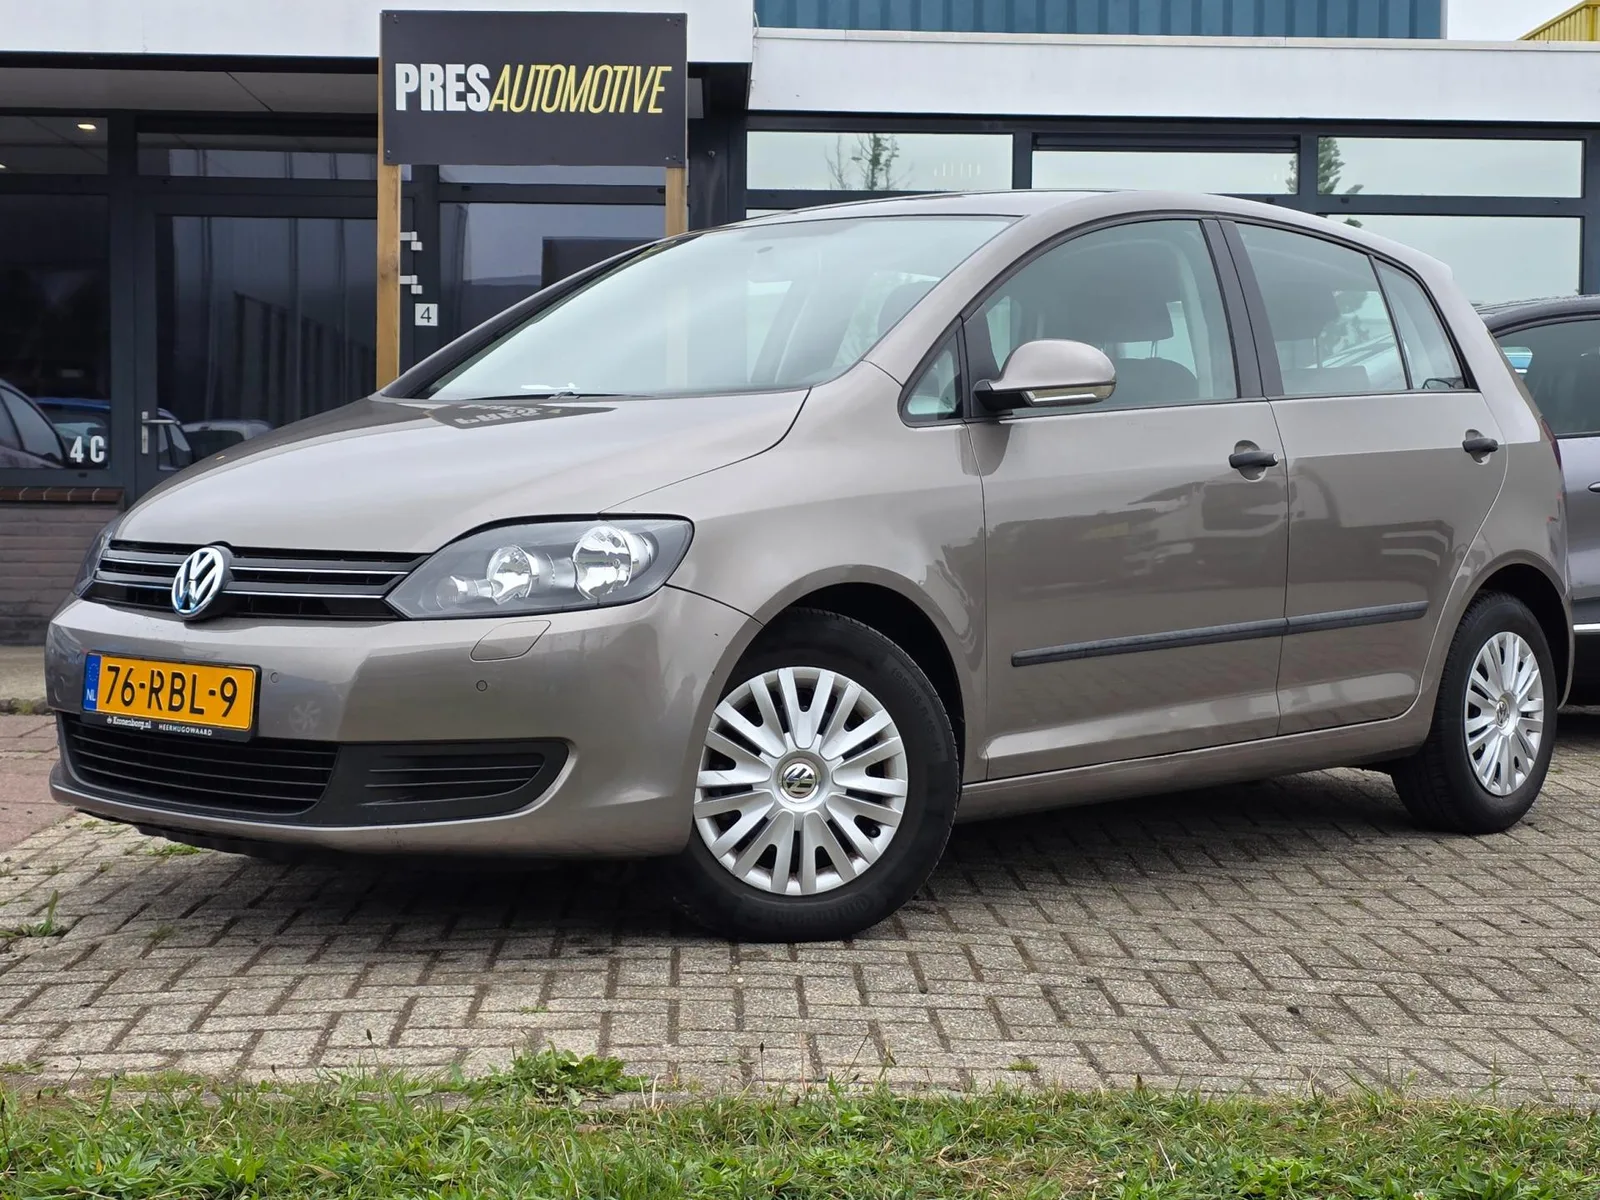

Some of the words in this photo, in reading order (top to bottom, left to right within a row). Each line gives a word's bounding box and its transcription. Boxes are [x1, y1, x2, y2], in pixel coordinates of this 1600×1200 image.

[420, 306, 432, 323] 4
[86, 688, 96, 701] NL
[105, 665, 238, 718] 76-RBL-9
[158, 723, 213, 736] HEERHUGOWAARD
